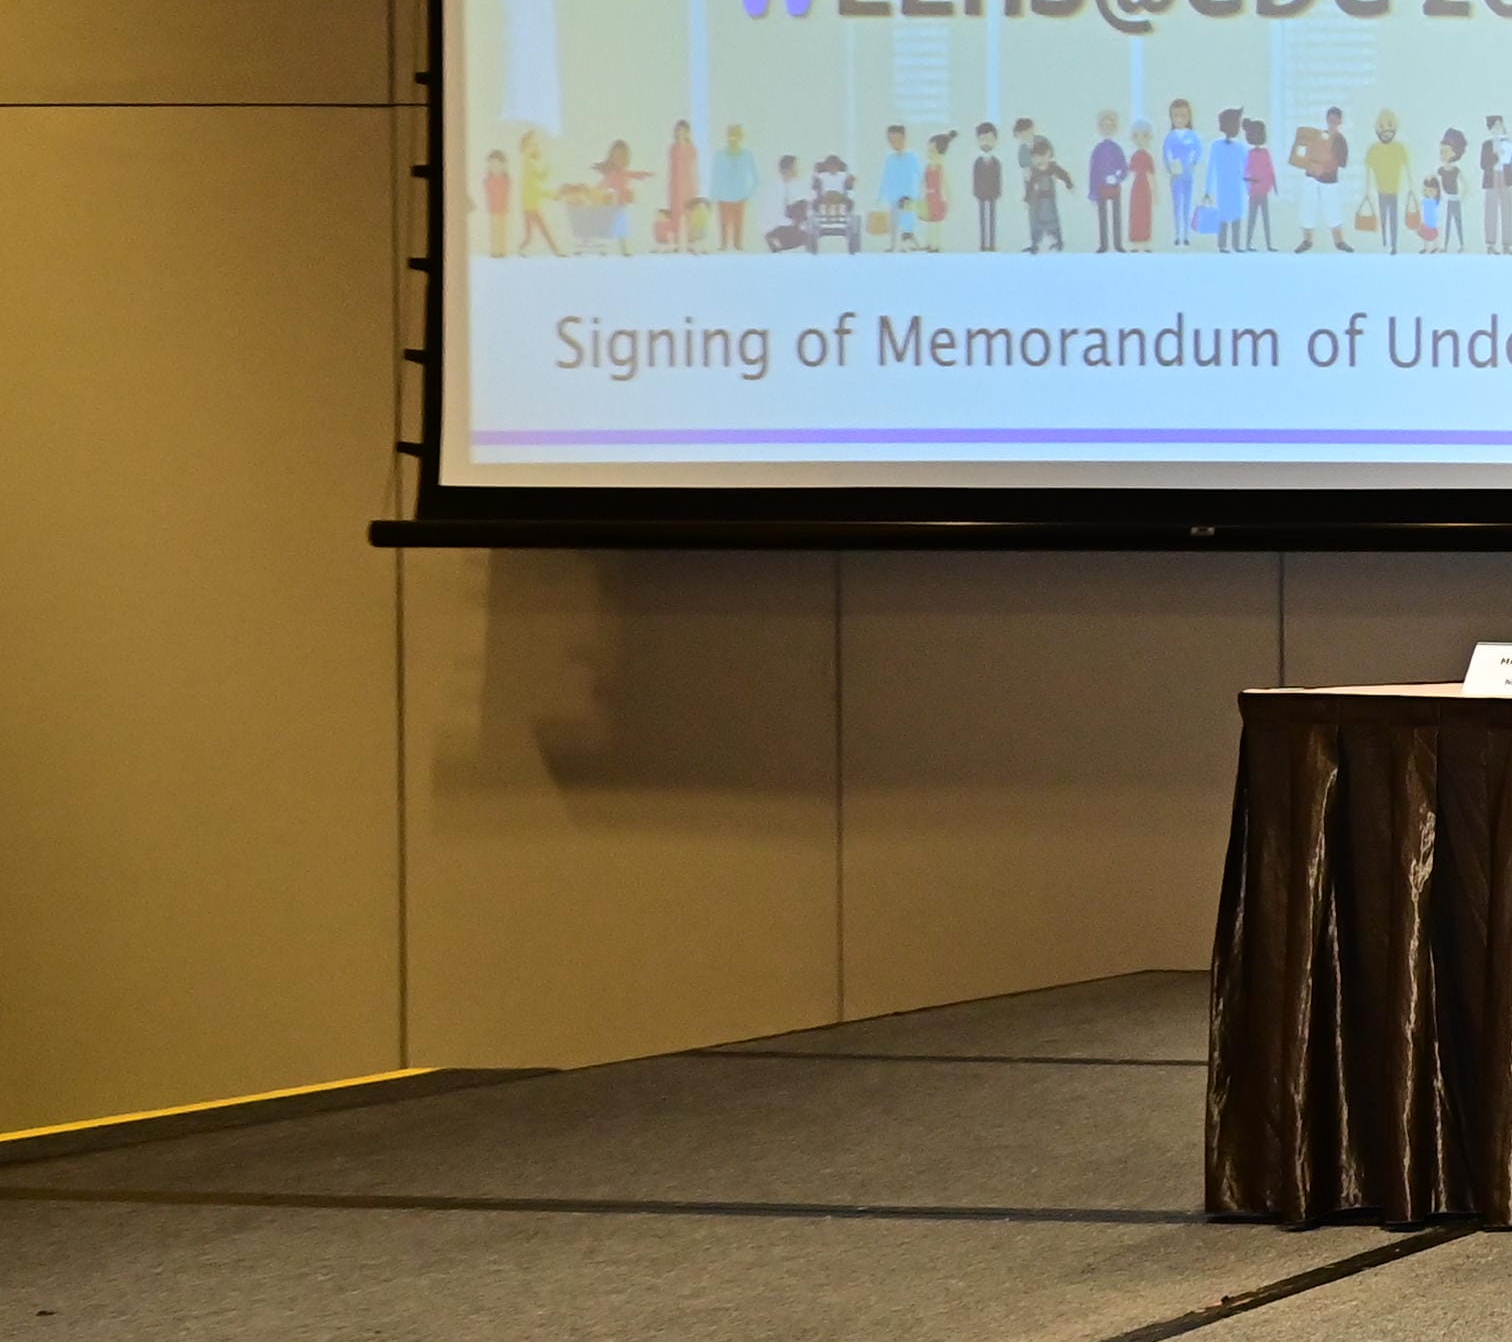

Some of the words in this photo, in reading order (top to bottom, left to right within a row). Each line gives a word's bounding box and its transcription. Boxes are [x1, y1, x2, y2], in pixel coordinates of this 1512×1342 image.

[555, 315, 771, 381] Signing
[796, 311, 857, 368] of
[877, 311, 1281, 368] Memorandum
[1306, 311, 1368, 368] of
